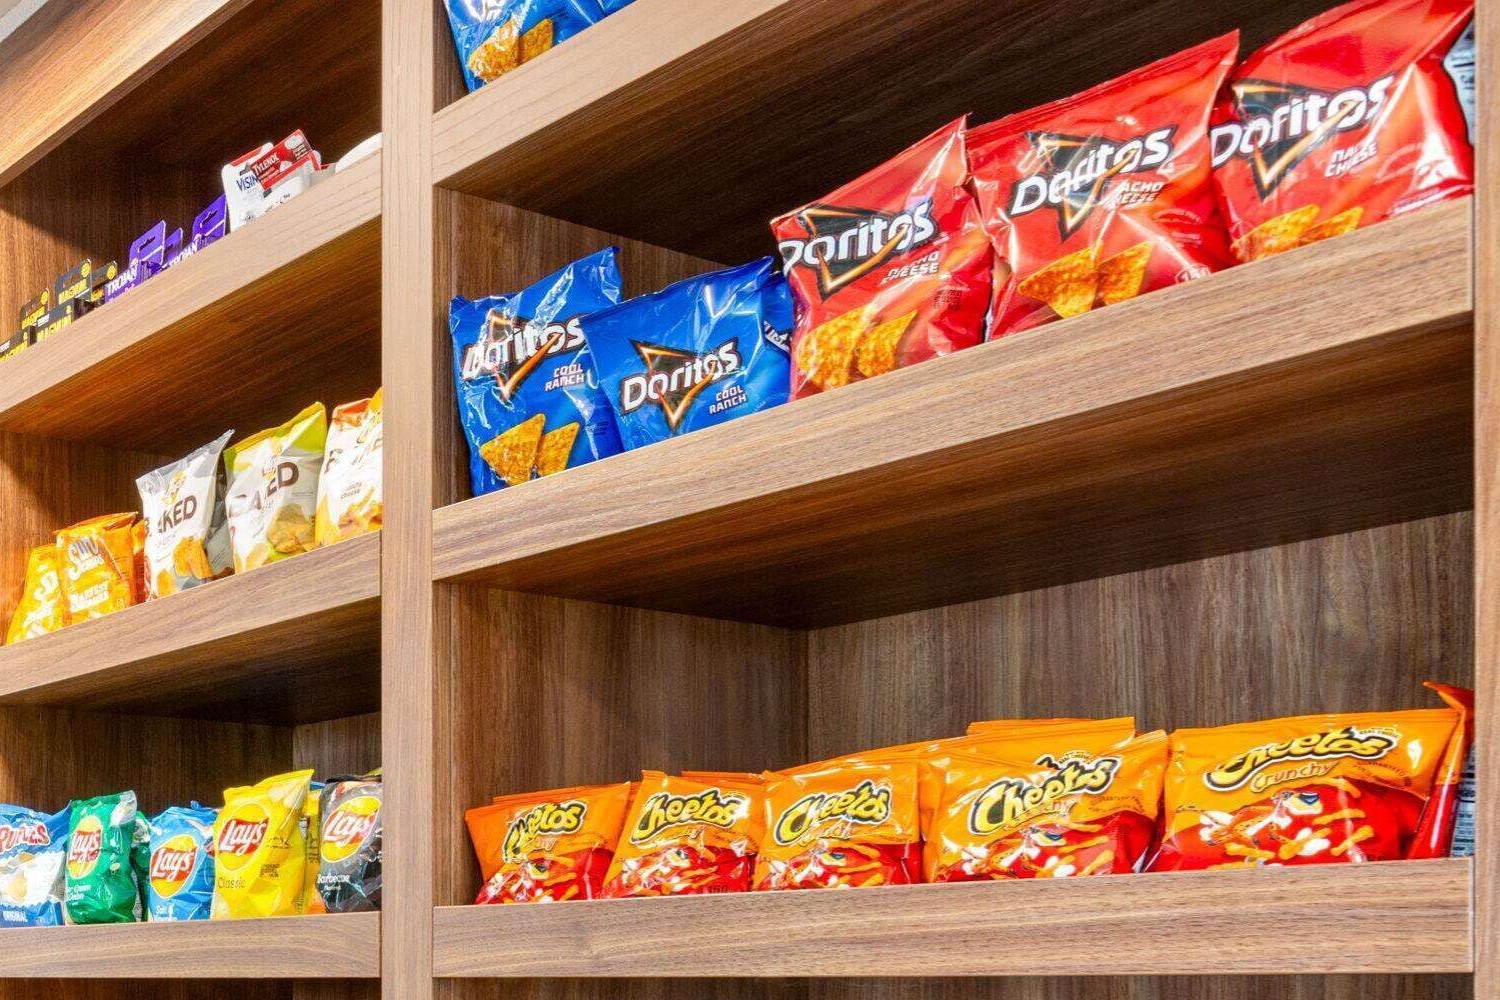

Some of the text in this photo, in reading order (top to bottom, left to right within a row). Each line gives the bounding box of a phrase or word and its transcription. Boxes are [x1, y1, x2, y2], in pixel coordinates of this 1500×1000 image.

[1211, 74, 1396, 168] Doritos
[236, 174, 258, 191] VISIN
[778, 199, 935, 277] Doritos
[107, 265, 138, 296] TROJAN
[462, 317, 588, 380] Doritos
[544, 374, 584, 392] RANCH
[554, 363, 583, 378] COOL
[622, 340, 741, 412] Doritos
[709, 394, 747, 415] RANCH
[715, 385, 744, 401] COOL
[1204, 728, 1397, 792] Cheetos
[1251, 761, 1338, 792] Crunchy
[775, 779, 891, 845] Cheetos
[969, 757, 1120, 834] Cheetos
[631, 788, 747, 845] Cheetos
[219, 819, 268, 856] Lay's
[152, 849, 195, 882] Lay's
[218, 877, 245, 889] Classic
[2, 910, 28, 923] ORIGINAL
